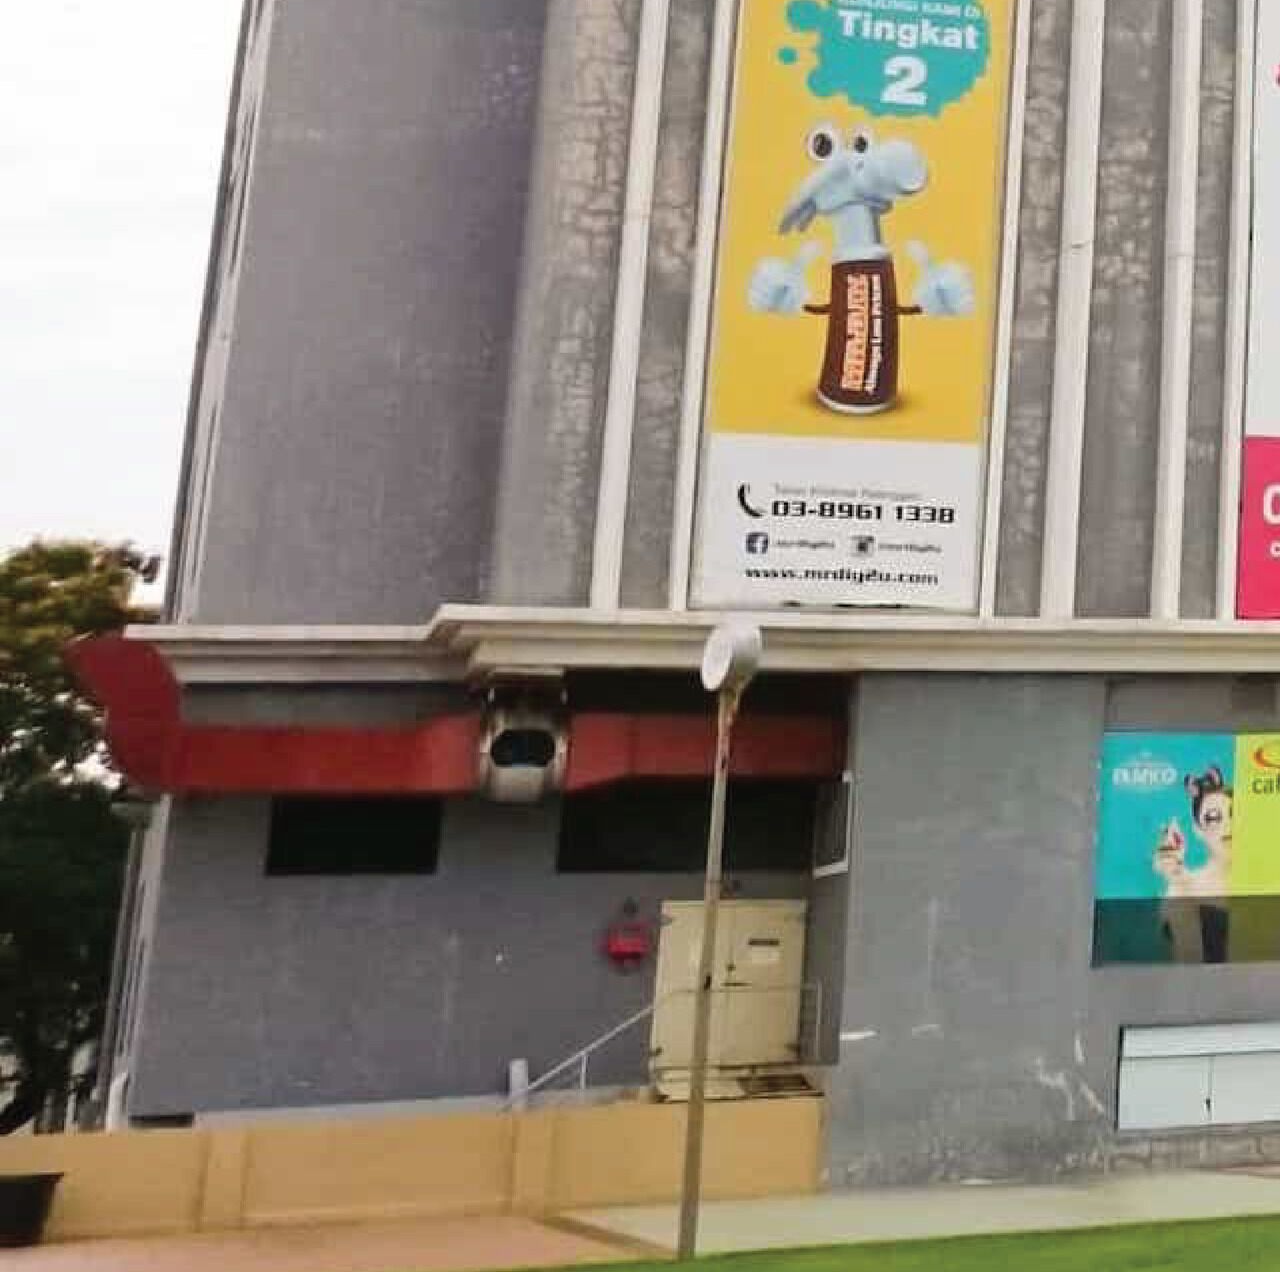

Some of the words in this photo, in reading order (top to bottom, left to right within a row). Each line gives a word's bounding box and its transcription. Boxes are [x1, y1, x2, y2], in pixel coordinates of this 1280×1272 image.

[838, 9, 979, 49] Tingkat
[880, 56, 929, 106] 2
[771, 500, 882, 521] 03-8961
[896, 504, 955, 524] 1338
